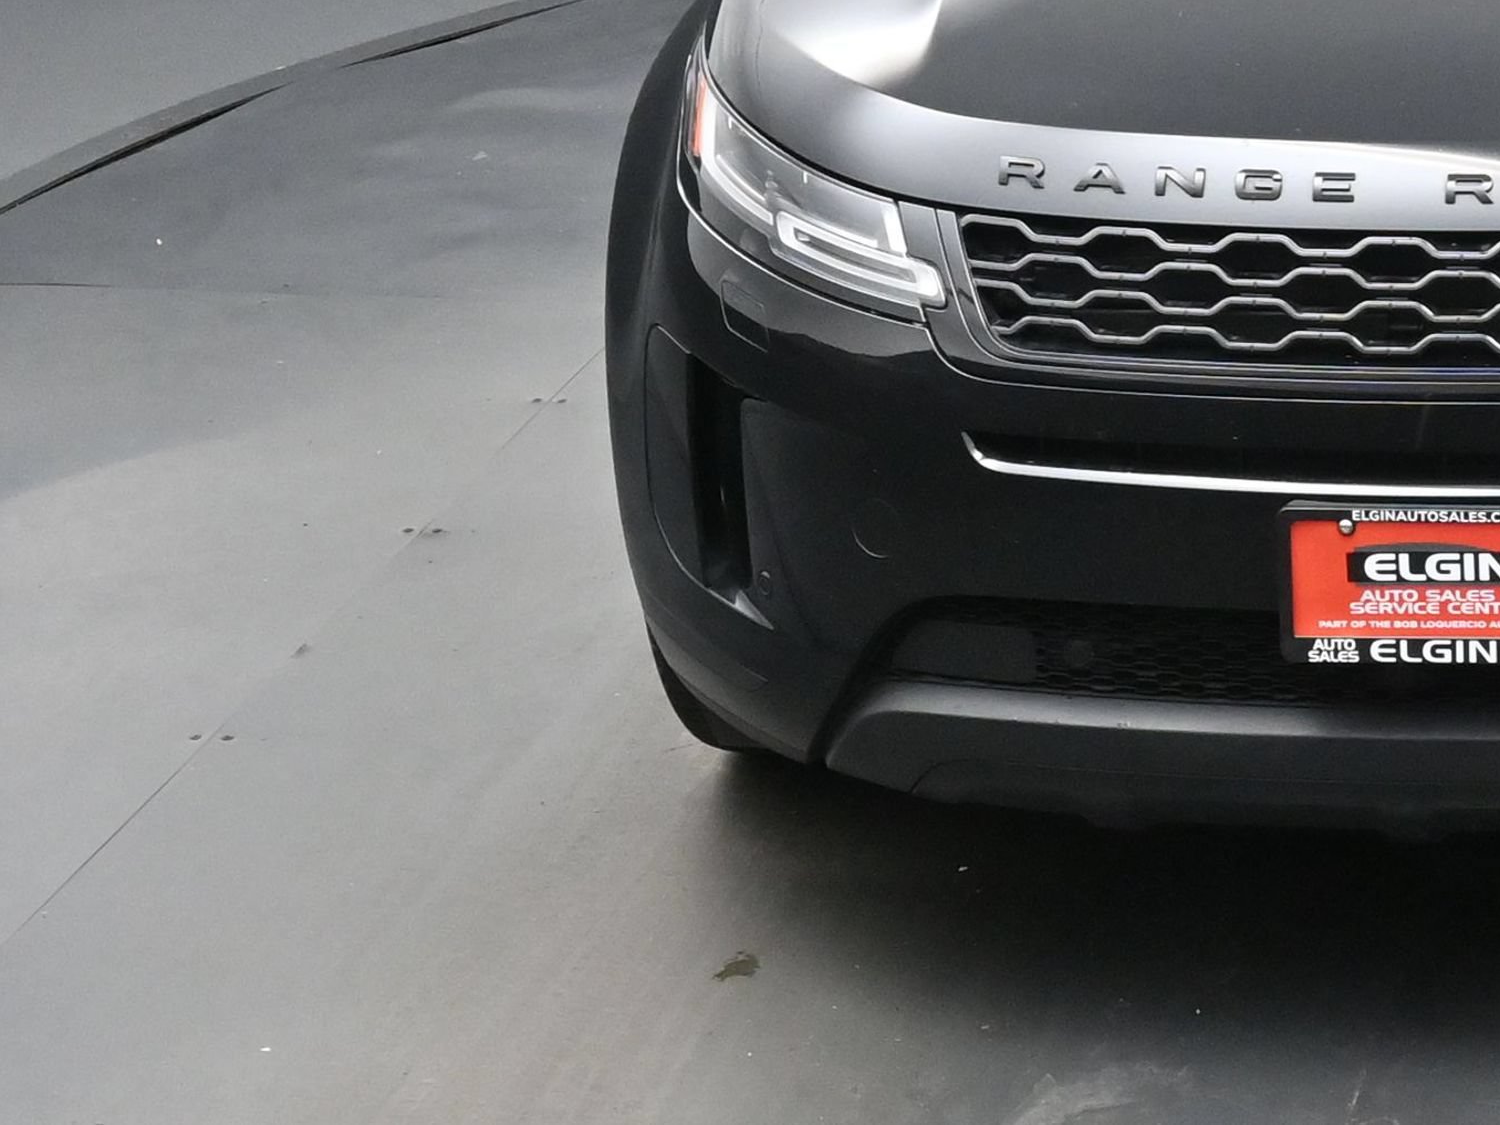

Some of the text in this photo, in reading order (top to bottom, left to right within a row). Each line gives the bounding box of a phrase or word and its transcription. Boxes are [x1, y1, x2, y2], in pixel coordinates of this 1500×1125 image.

[997, 155, 1357, 203] RANGE
[1359, 589, 1419, 602] AUTO
[1425, 589, 1495, 602] SALES
[1349, 602, 1440, 615] SERVICE
[1318, 620, 1348, 629] PART
[1350, 620, 1367, 629] OF
[1368, 620, 1391, 629] THE
[1393, 620, 1418, 629] BOB
[1312, 638, 1357, 651] AUTO
[1307, 650, 1360, 664] SALES
[1369, 639, 1498, 664] ELGIN
